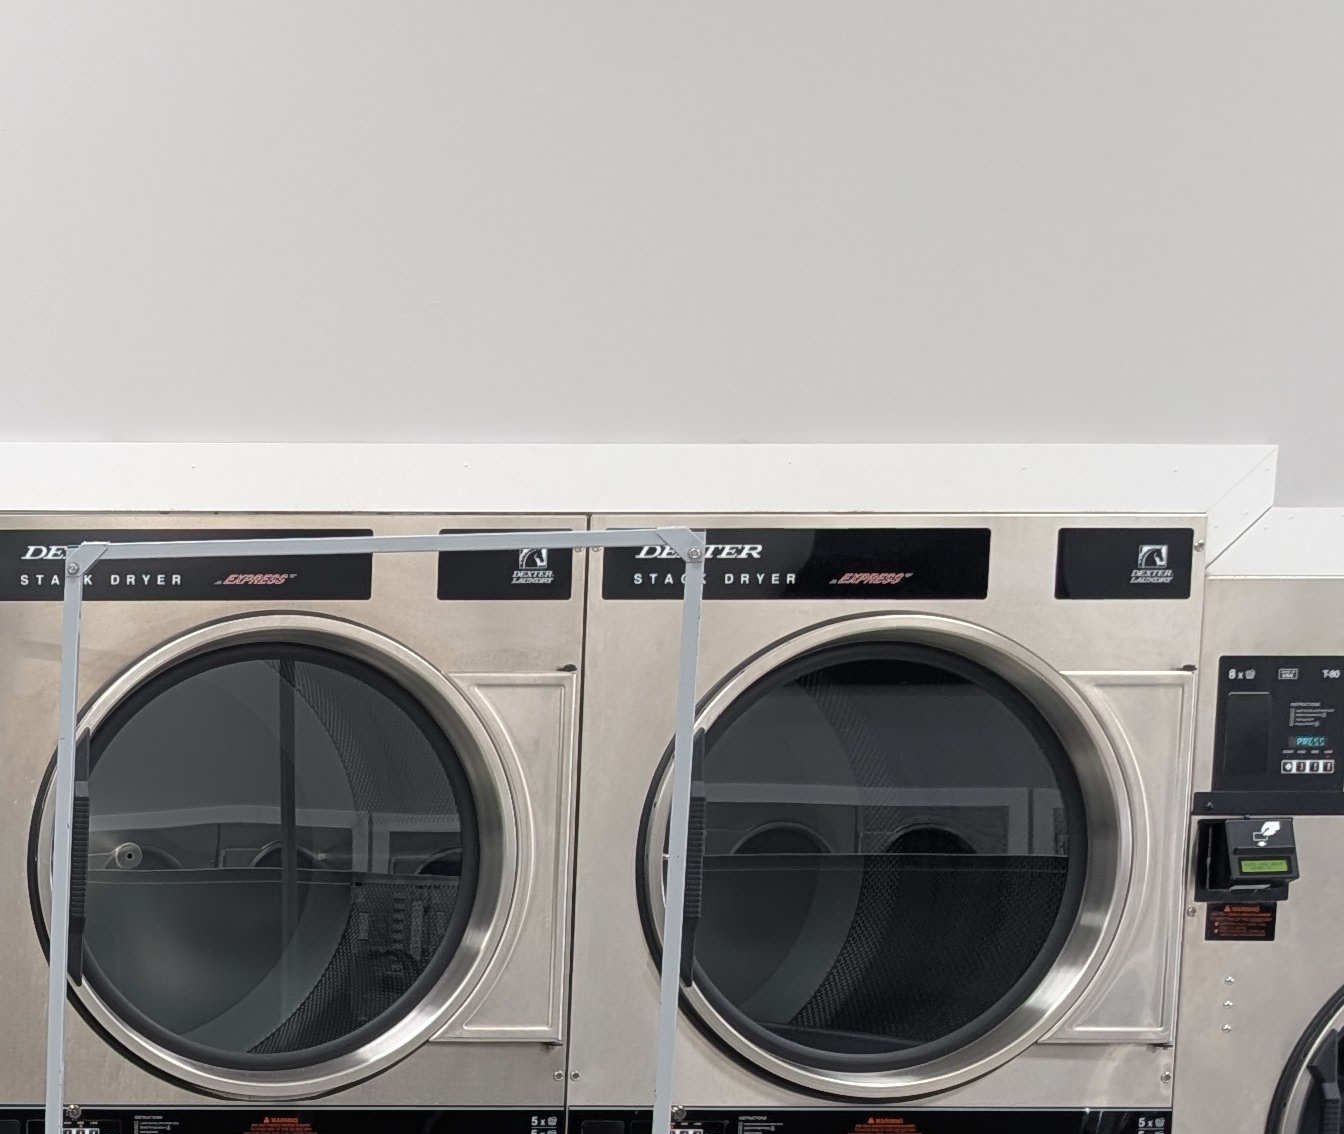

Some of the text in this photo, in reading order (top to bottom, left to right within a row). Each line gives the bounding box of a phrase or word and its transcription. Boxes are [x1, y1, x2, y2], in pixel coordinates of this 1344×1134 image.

[634, 544, 763, 559] DETER
[223, 573, 289, 585] EXPRESS
[724, 573, 796, 585] DRYER
[837, 572, 905, 585] EXPRESS
[1131, 569, 1173, 577] DEXTER
[20, 574, 182, 586] STAK DRYER
[531, 1116, 546, 1126] 5 x
[1138, 1117, 1146, 1128] 5
